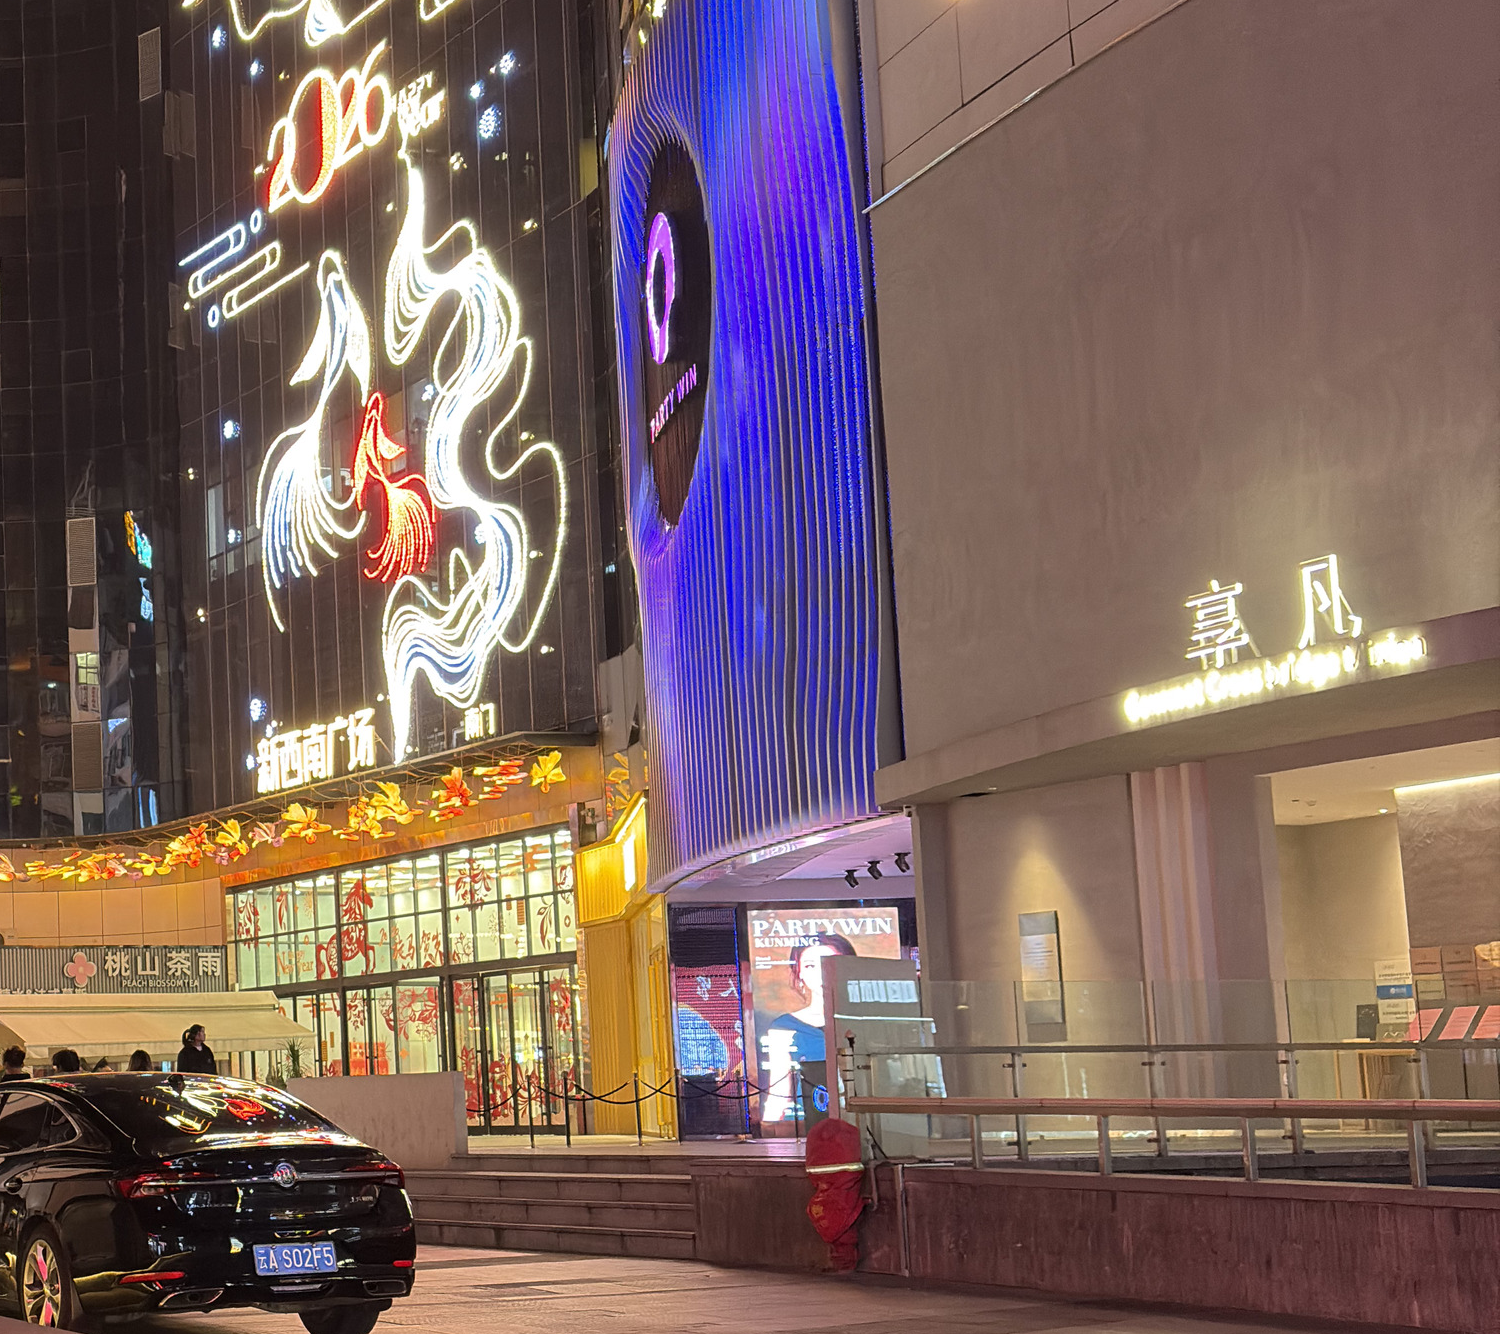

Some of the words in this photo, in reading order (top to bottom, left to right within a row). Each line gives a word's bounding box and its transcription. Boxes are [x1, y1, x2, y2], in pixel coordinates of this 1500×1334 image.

[267, 38, 392, 213] 2026
[650, 388, 675, 444] PARTY
[675, 364, 698, 404] WIN
[257, 707, 375, 793] 新西南广场
[752, 917, 892, 937] PARTYWIN
[754, 936, 820, 948] KUNMING
[104, 951, 222, 977] 桃山茶雨
[122, 979, 147, 988] PEACH
[184, 978, 199, 987] TEA
